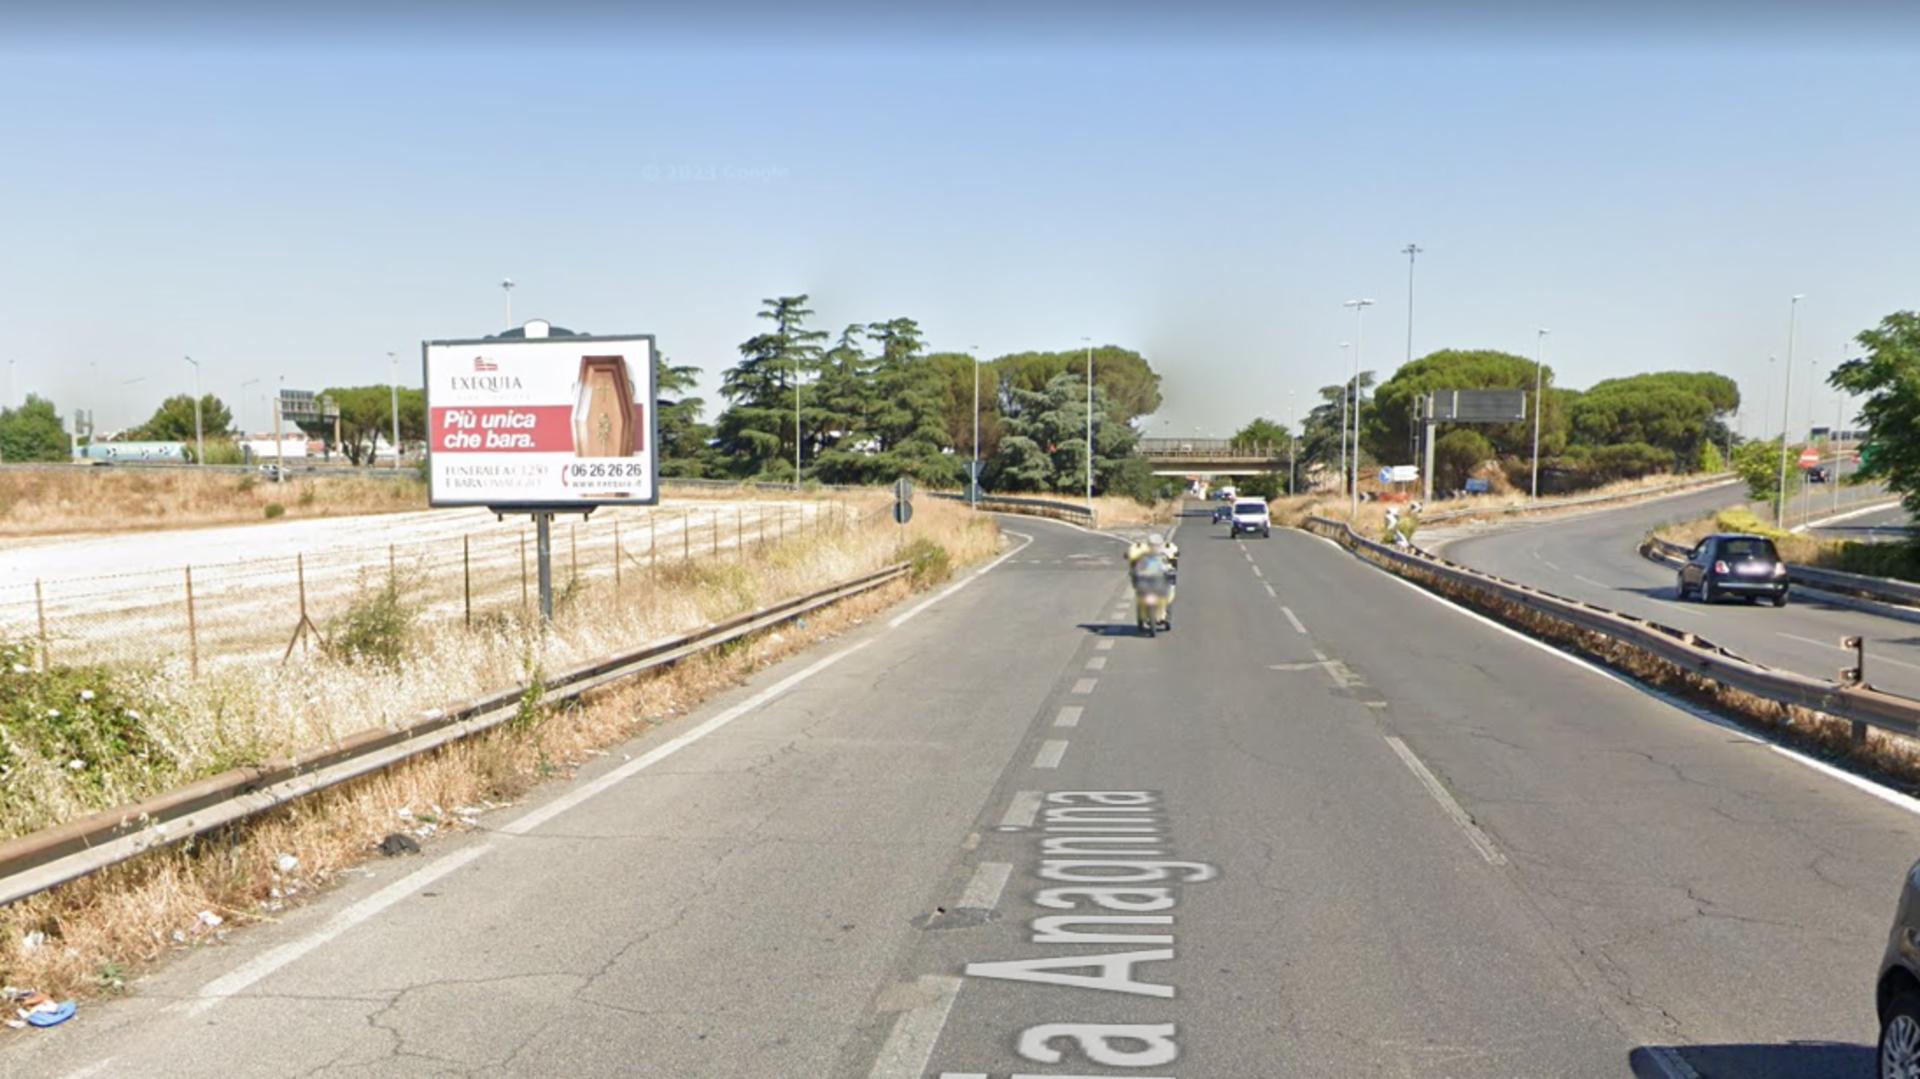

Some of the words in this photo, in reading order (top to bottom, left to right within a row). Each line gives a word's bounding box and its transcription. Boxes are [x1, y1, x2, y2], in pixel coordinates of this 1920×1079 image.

[450, 376, 523, 392] EXEQUIA
[443, 410, 476, 429] Più
[481, 409, 537, 429] unica
[443, 429, 481, 448] che
[485, 429, 535, 449] bara.
[571, 463, 588, 477] 06
[590, 463, 606, 477] 26
[608, 463, 624, 477] 26
[626, 463, 642, 477] 26
